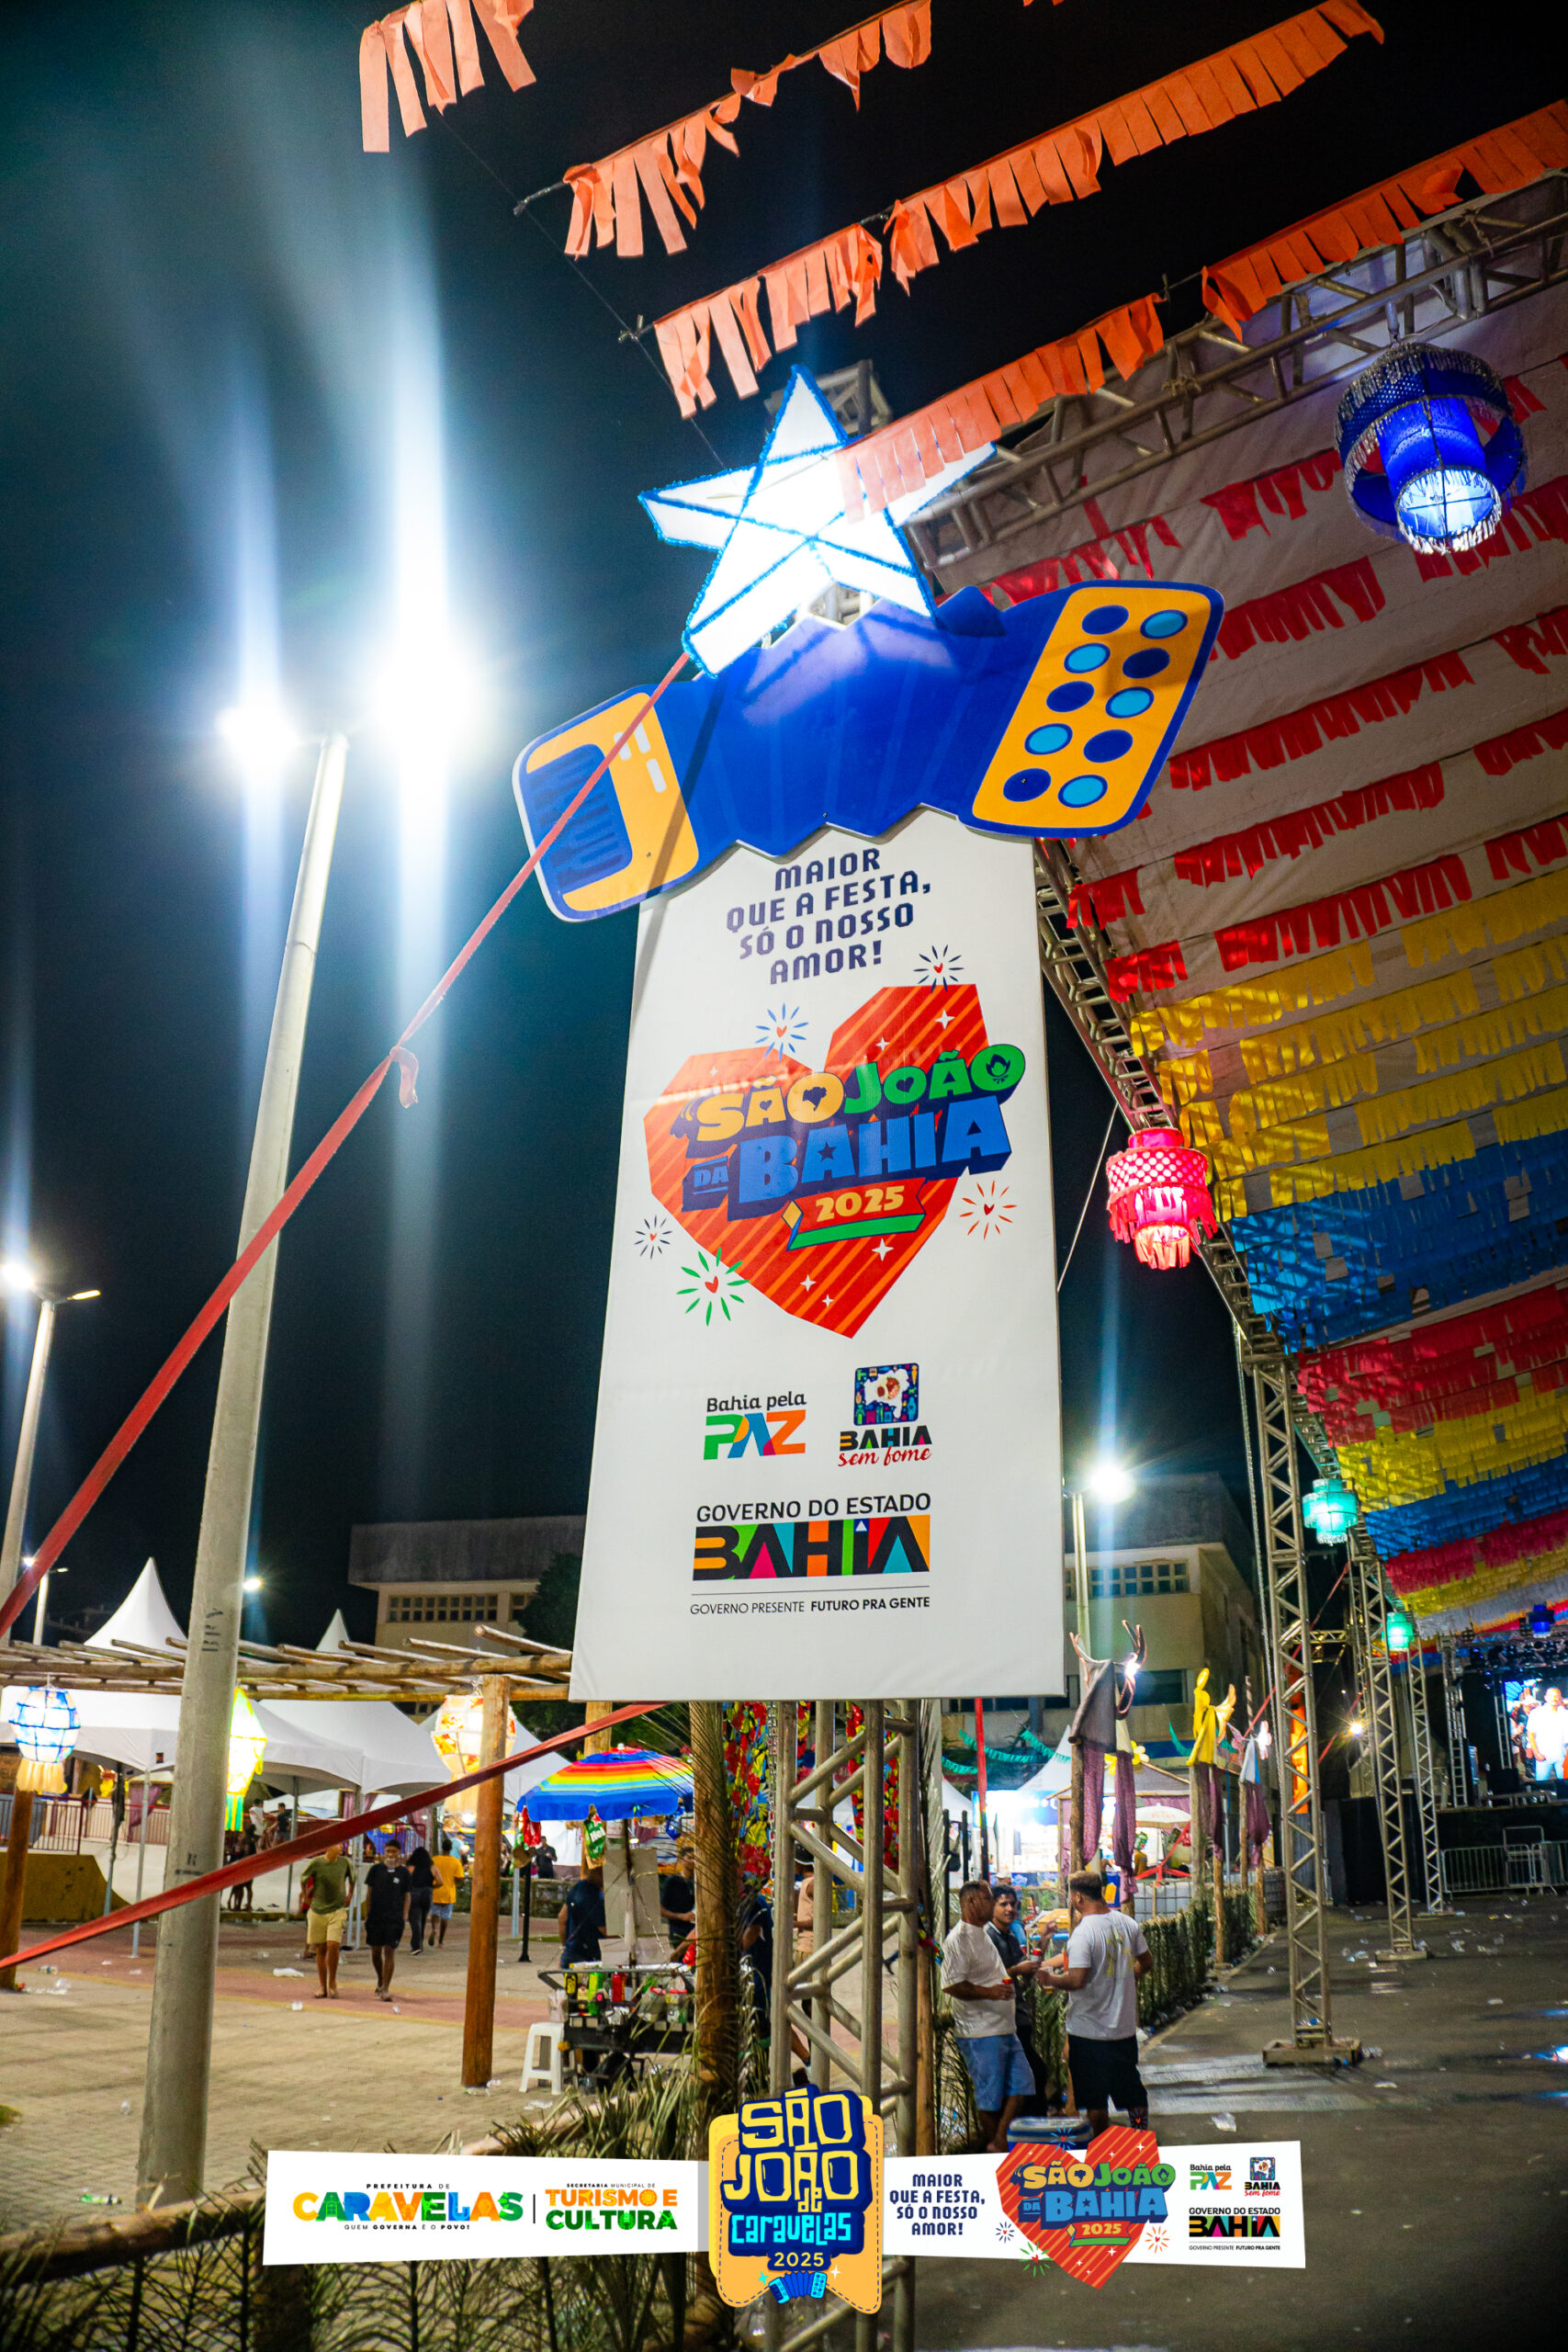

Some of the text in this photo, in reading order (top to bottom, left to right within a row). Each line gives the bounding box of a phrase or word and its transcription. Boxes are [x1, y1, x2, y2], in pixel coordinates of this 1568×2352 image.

[775, 848, 880, 891] MAIOR
[727, 870, 931, 933] QUE A FESTA,
[739, 902, 913, 959] SÓ O NOSSO
[770, 940, 882, 985] AMOR!
[695, 1044, 1026, 1142] SÃO JOÃO
[694, 1096, 1011, 1204] DA BAHIA
[815, 1185, 905, 1223] 2025
[706, 1391, 807, 1414] Bahia pela
[704, 1409, 806, 1460] PAZ
[838, 1446, 932, 1466] sem fome
[840, 1425, 932, 1451] BAHIA
[696, 1493, 931, 1522] GOVERNO DO ESTADO
[693, 1514, 931, 1581] BAHIA
[691, 1597, 930, 1615] GOVERNO PRESENTE FUTURO PRA GENTE
